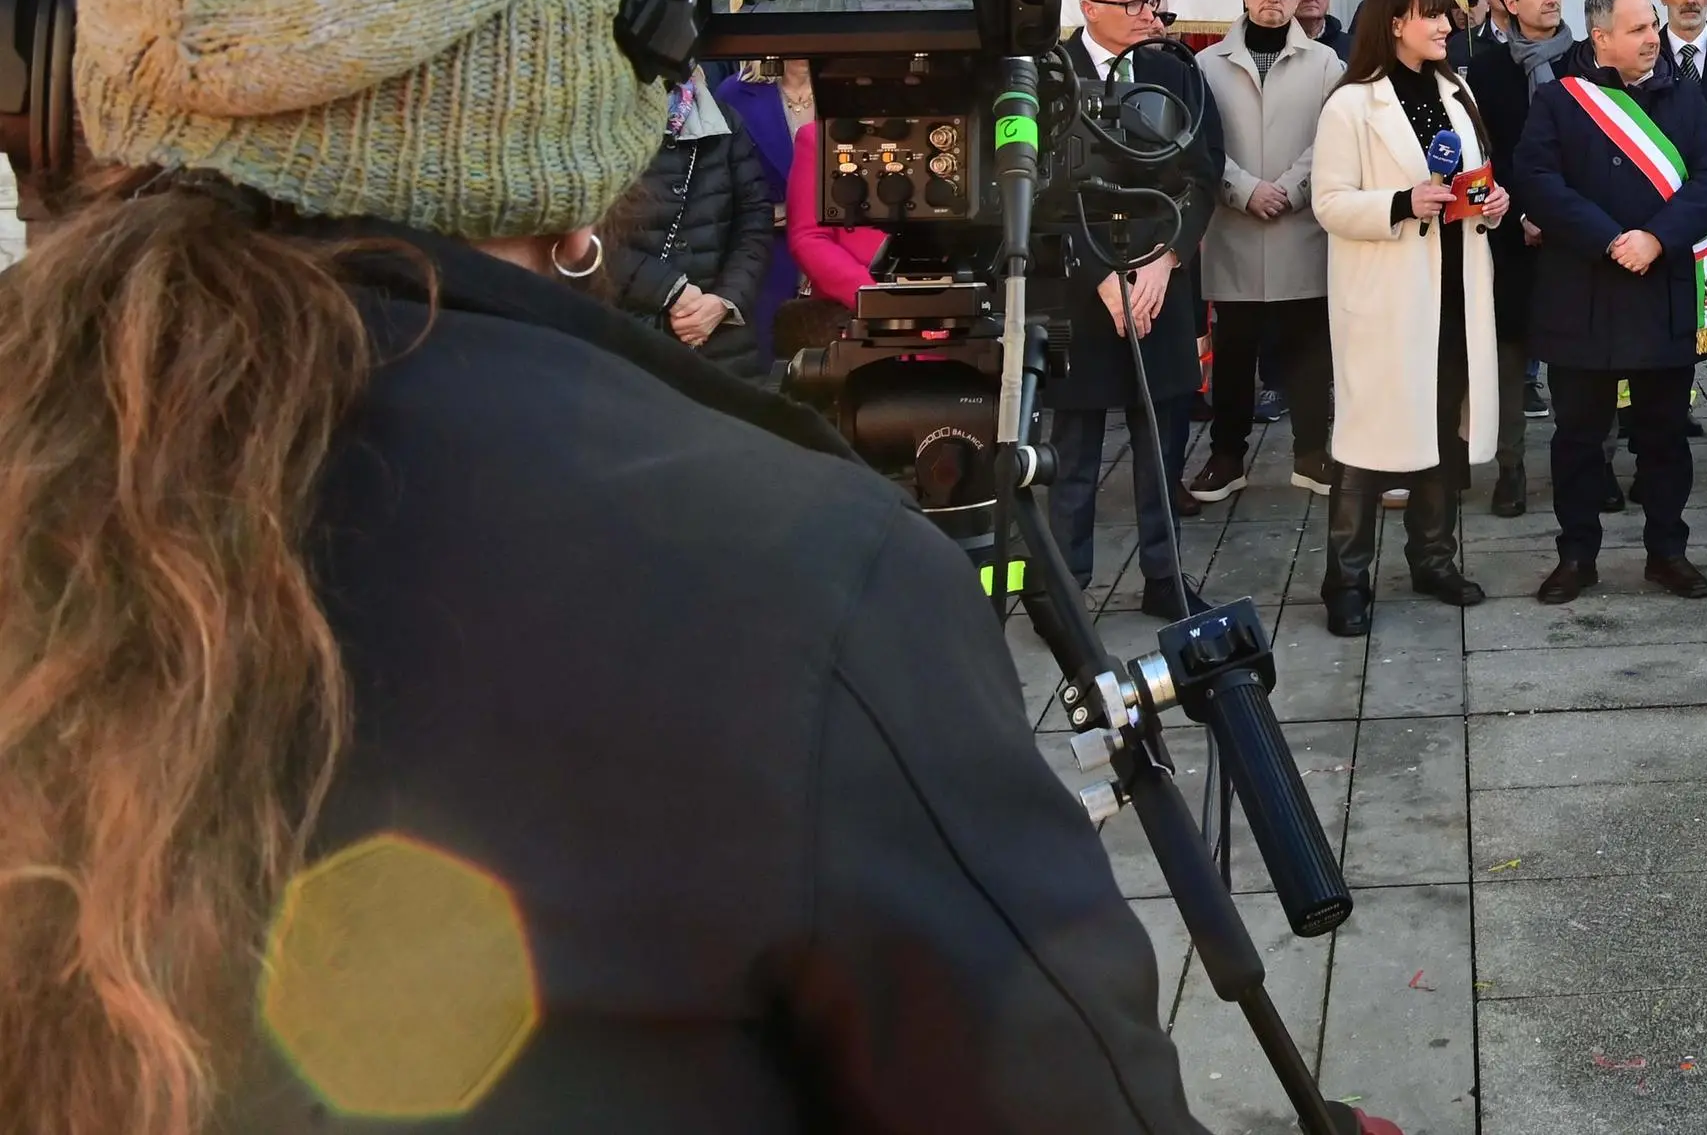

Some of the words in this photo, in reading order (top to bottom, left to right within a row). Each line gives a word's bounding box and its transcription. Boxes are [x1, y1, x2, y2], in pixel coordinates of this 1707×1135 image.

[952, 428, 985, 450] BALANCE
[1189, 627, 1201, 638] W
[1218, 616, 1228, 626] T
